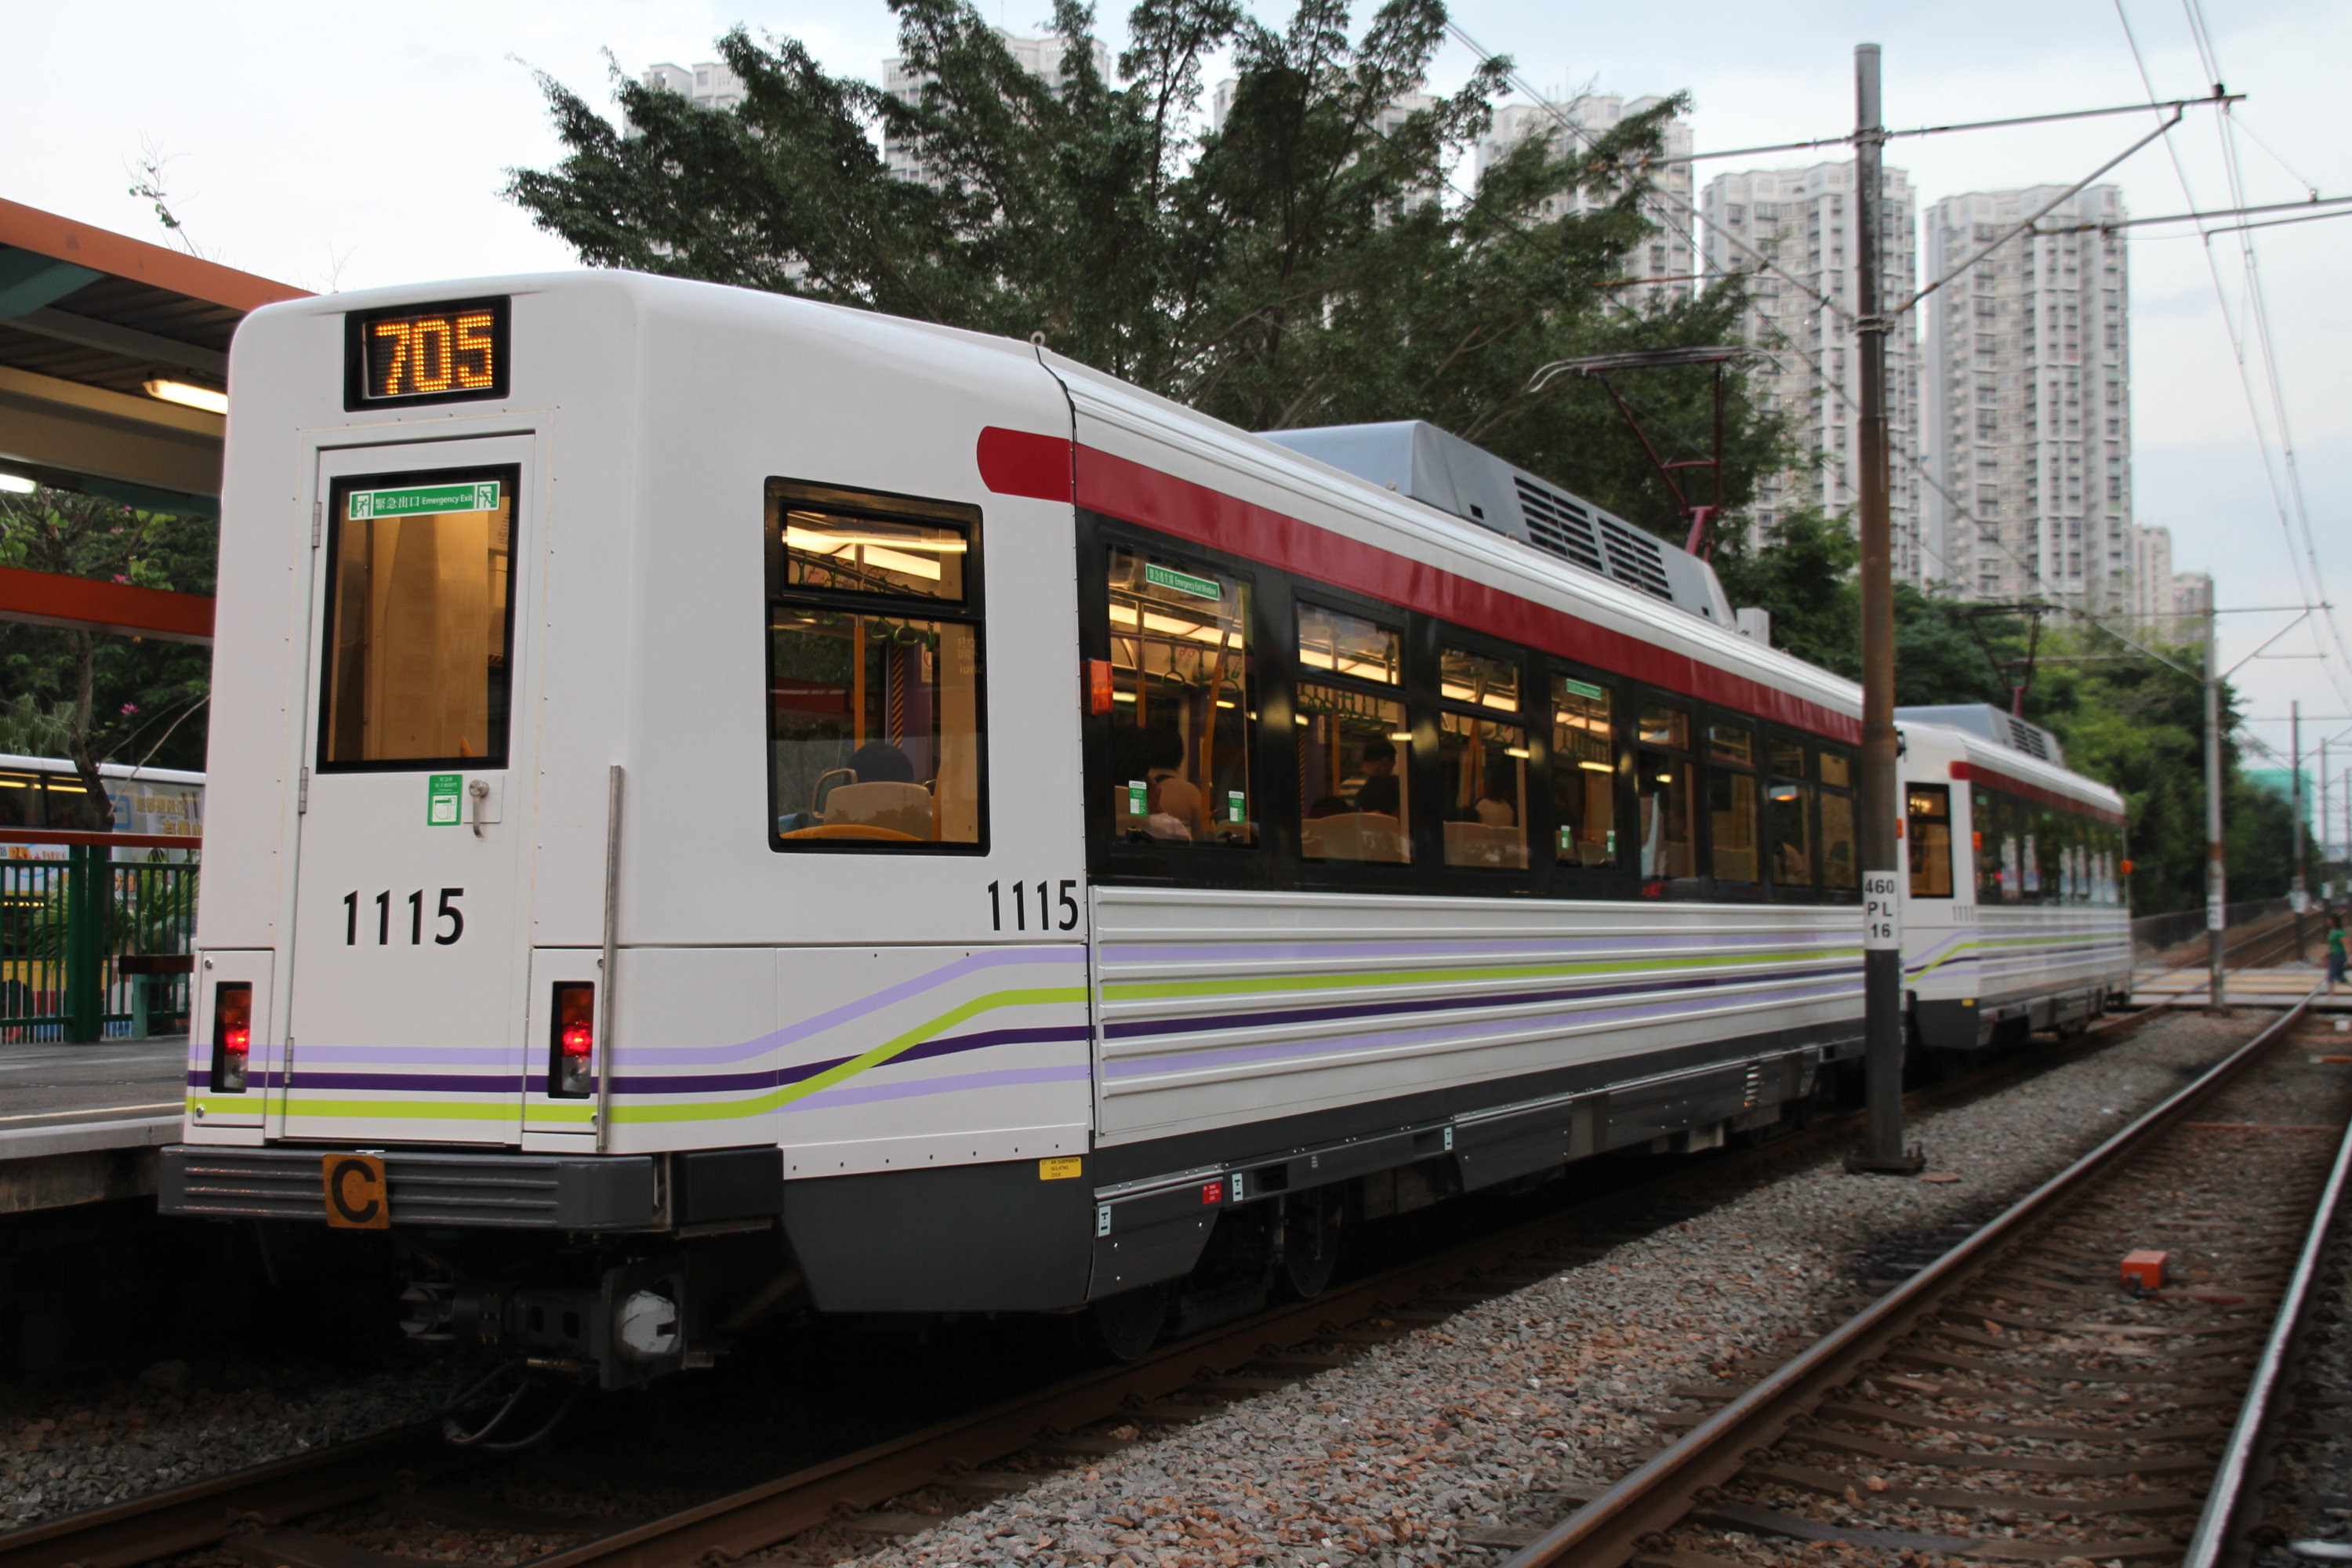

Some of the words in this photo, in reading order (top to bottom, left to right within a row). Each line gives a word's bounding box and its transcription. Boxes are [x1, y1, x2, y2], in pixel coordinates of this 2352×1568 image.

[375, 314, 493, 394] 705
[375, 495, 419, 510] 緊急出口
[422, 495, 459, 506] Emergency
[460, 494, 473, 503] Exit
[1174, 576, 1195, 591] Emergency
[1864, 879, 1894, 894] 460
[343, 887, 464, 946] 1115
[988, 879, 1079, 931] 1115
[1871, 924, 1891, 938] 16
[332, 1159, 379, 1223] C
